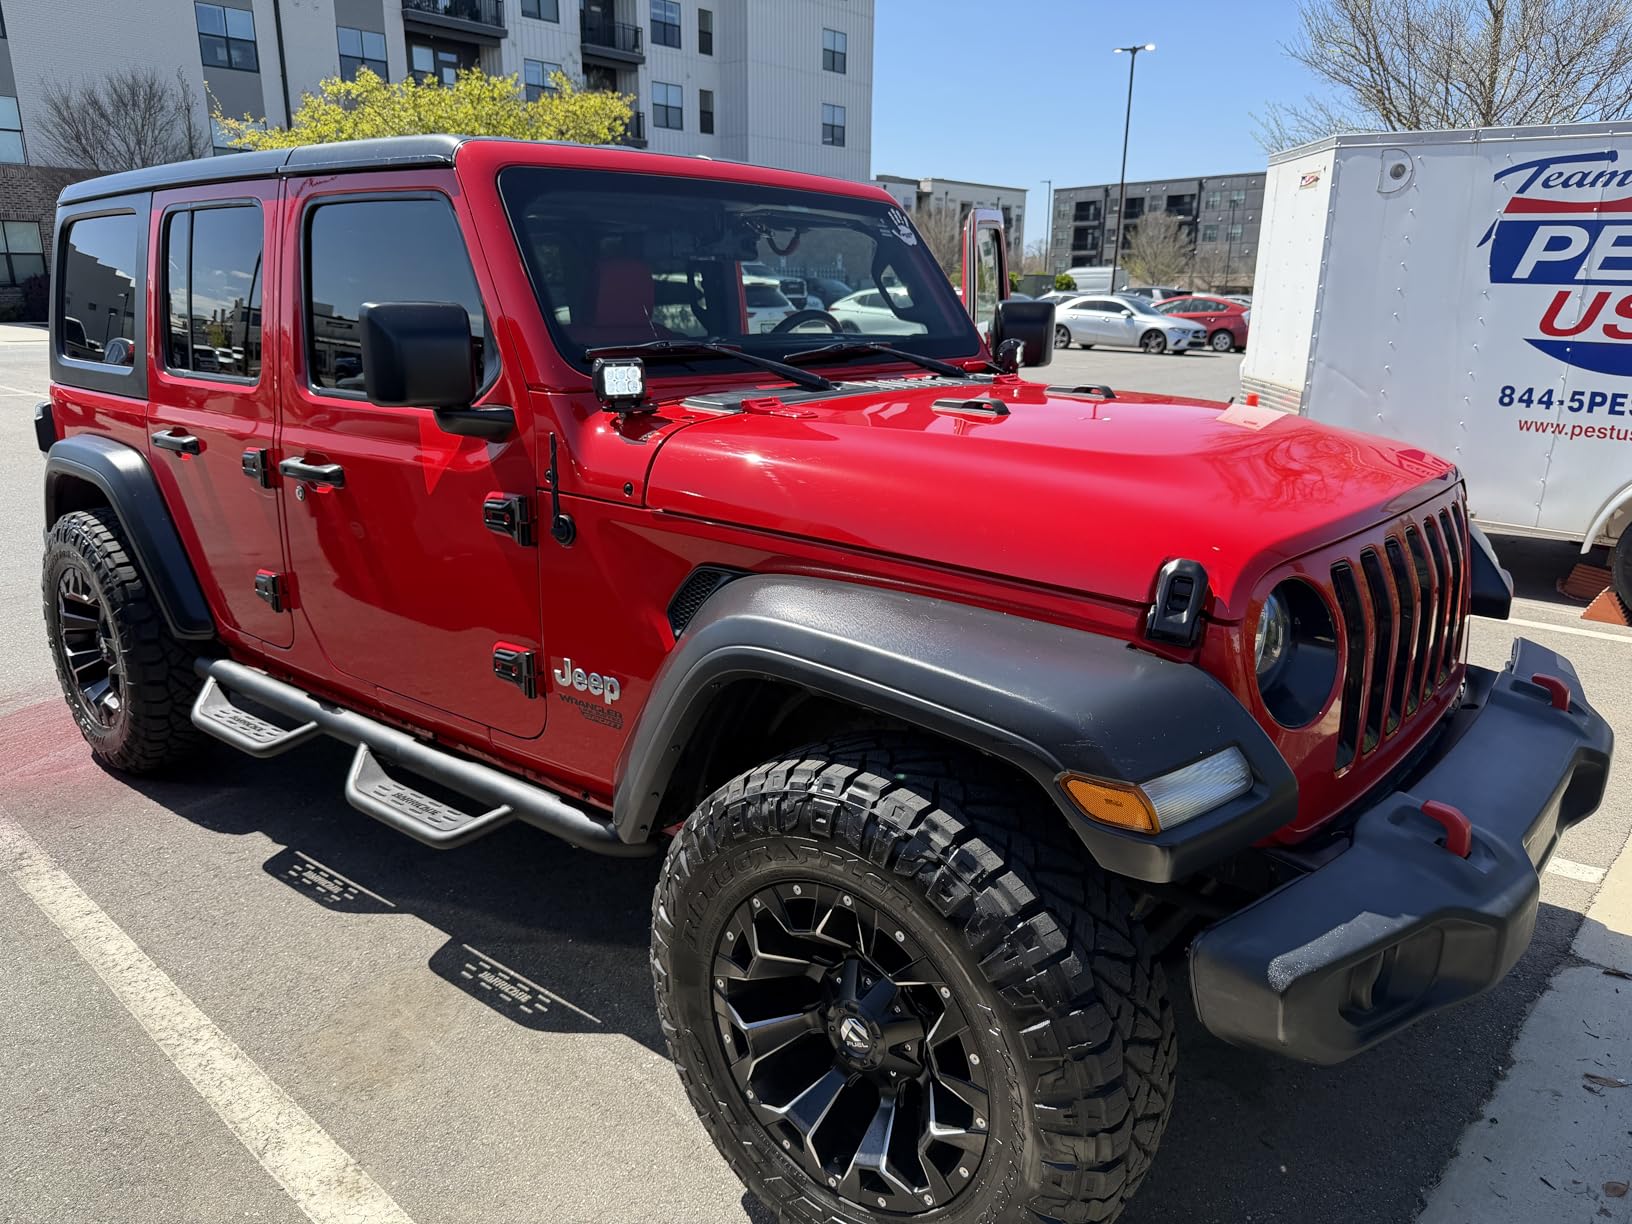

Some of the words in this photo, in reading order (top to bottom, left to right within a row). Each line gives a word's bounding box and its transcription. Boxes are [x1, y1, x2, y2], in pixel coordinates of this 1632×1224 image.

[1493, 149, 1632, 195] Team
[1498, 385, 1632, 416] 844-5PE
[553, 657, 621, 705] Jeep
[846, 1040, 869, 1048] FUEL
